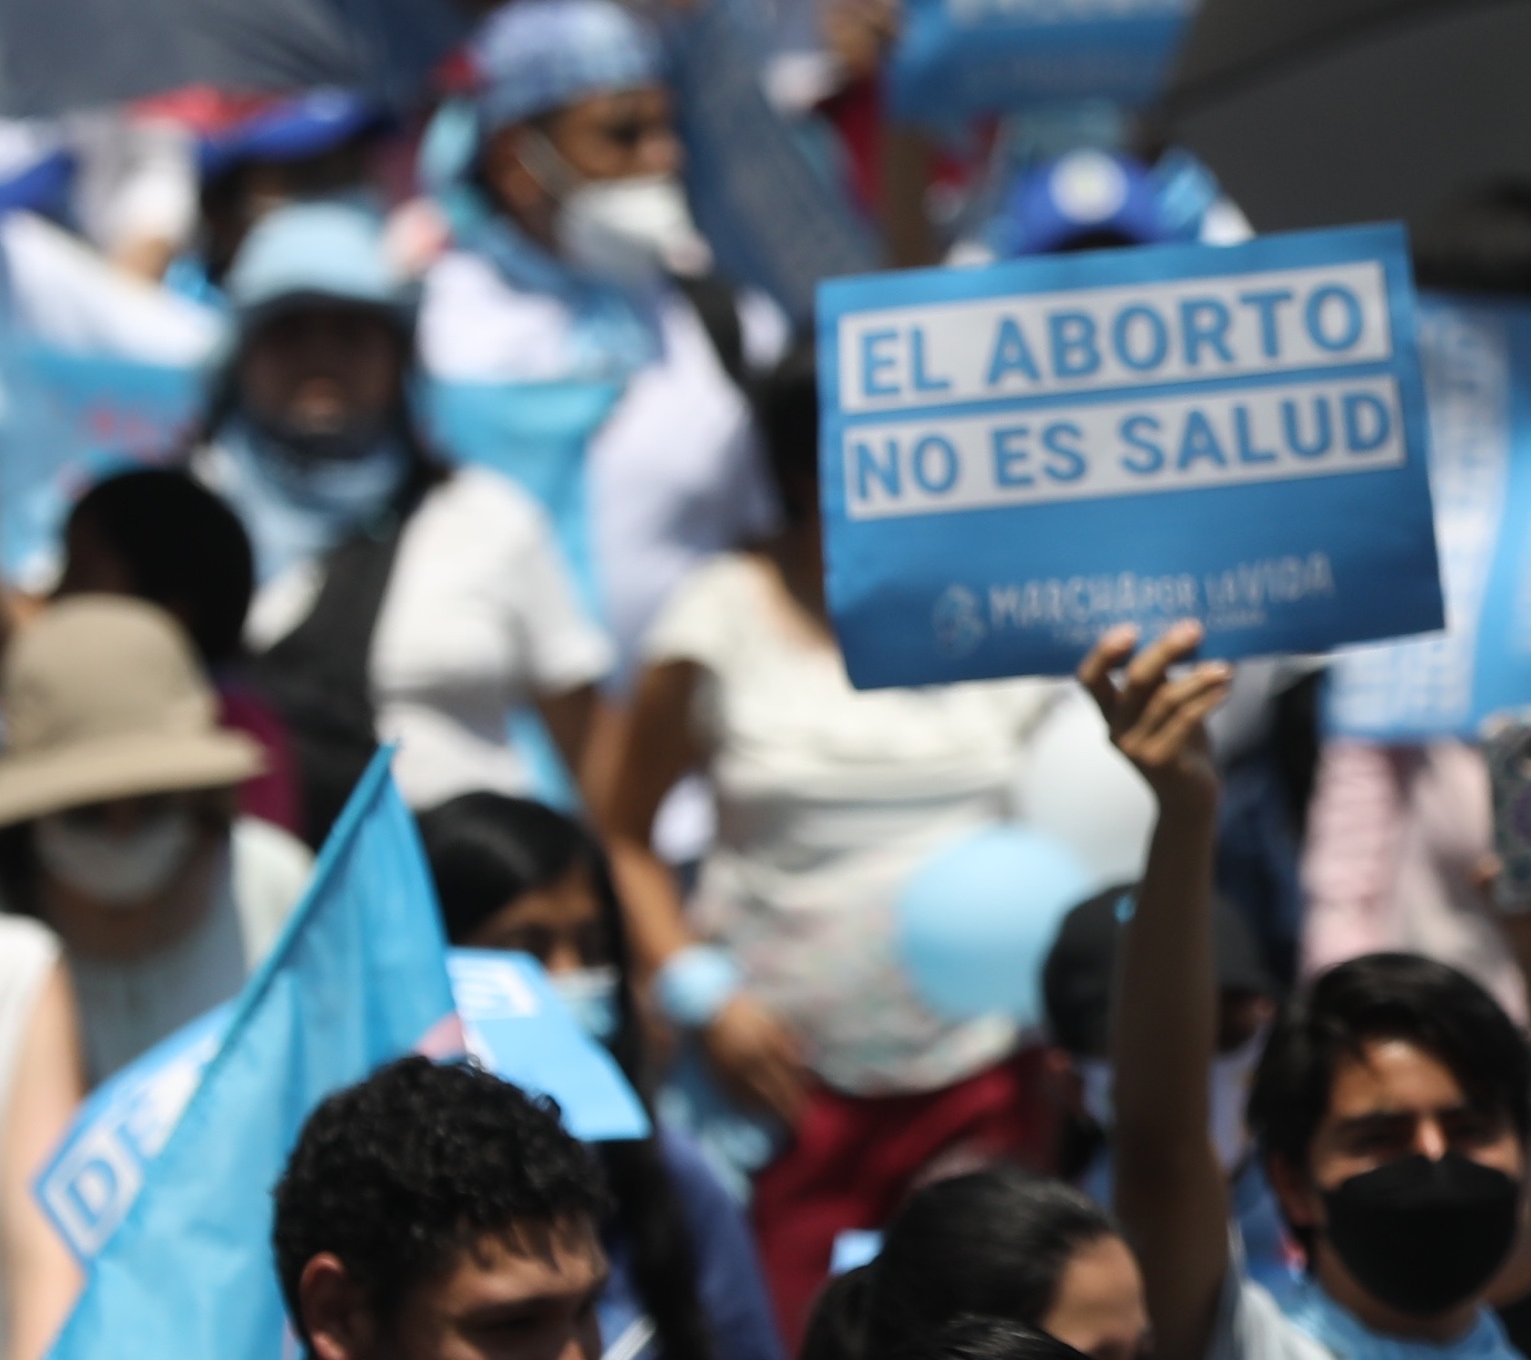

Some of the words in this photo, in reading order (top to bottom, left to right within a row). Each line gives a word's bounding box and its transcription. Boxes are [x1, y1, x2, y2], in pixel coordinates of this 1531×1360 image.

[860, 327, 950, 399] EL
[986, 283, 1365, 386] ABORTO
[855, 433, 959, 499] NO
[991, 422, 1087, 489] ES
[1119, 391, 1394, 476] SALUD
